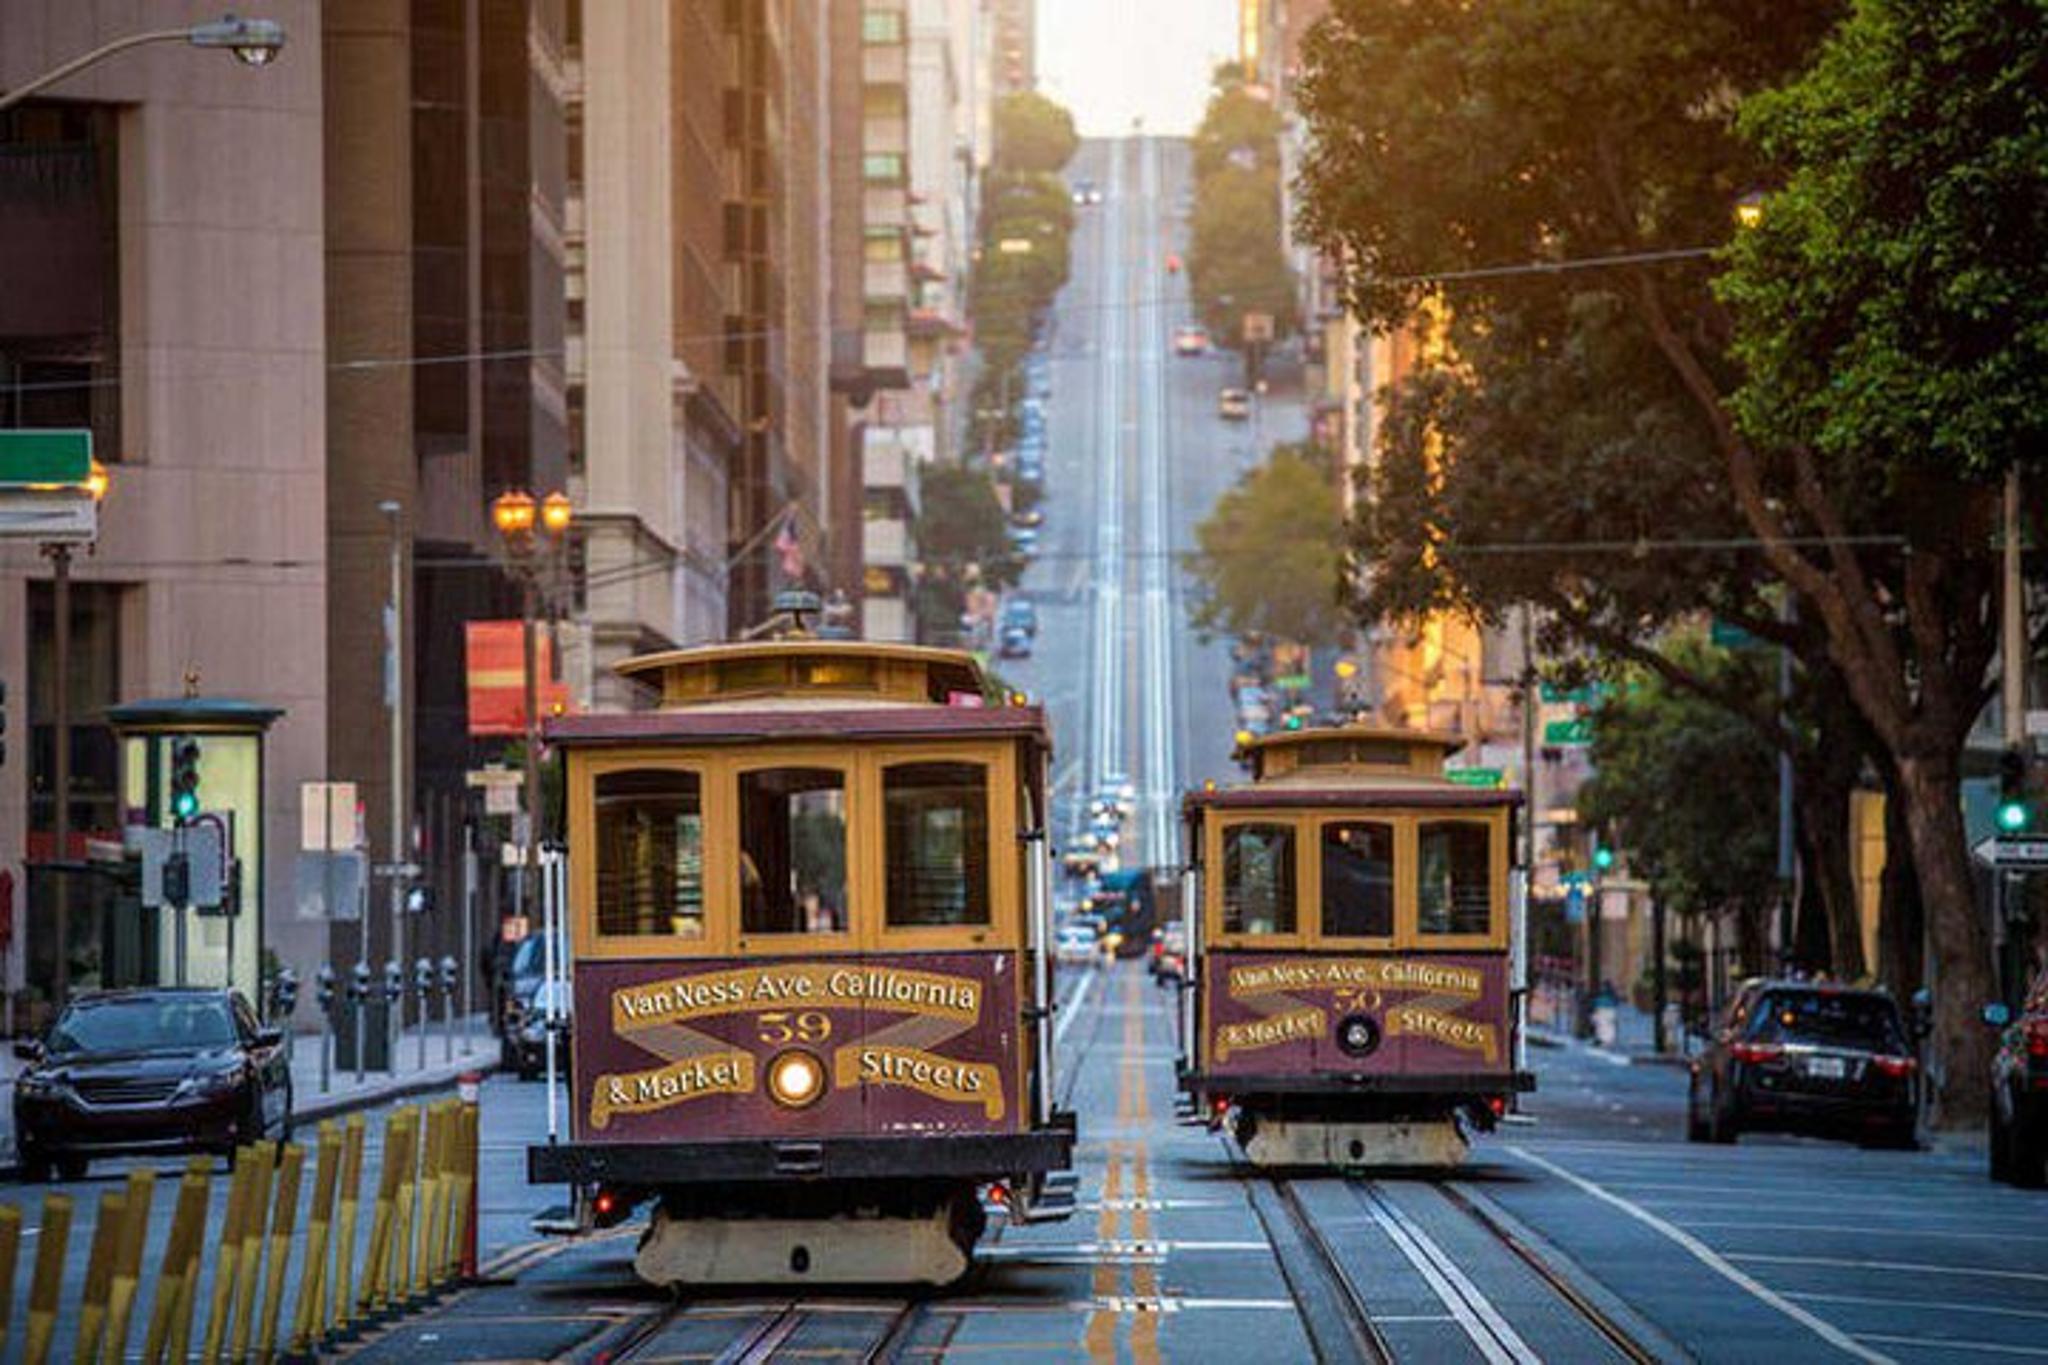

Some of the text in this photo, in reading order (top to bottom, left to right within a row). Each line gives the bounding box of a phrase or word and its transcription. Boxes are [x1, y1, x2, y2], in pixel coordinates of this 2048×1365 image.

[620, 993, 673, 1019] Van
[674, 981, 744, 1009] Ness
[829, 969, 975, 1010] California
[1381, 961, 1479, 991] California
[757, 1011, 832, 1044] 59
[608, 1050, 981, 1104] & Market Streets
